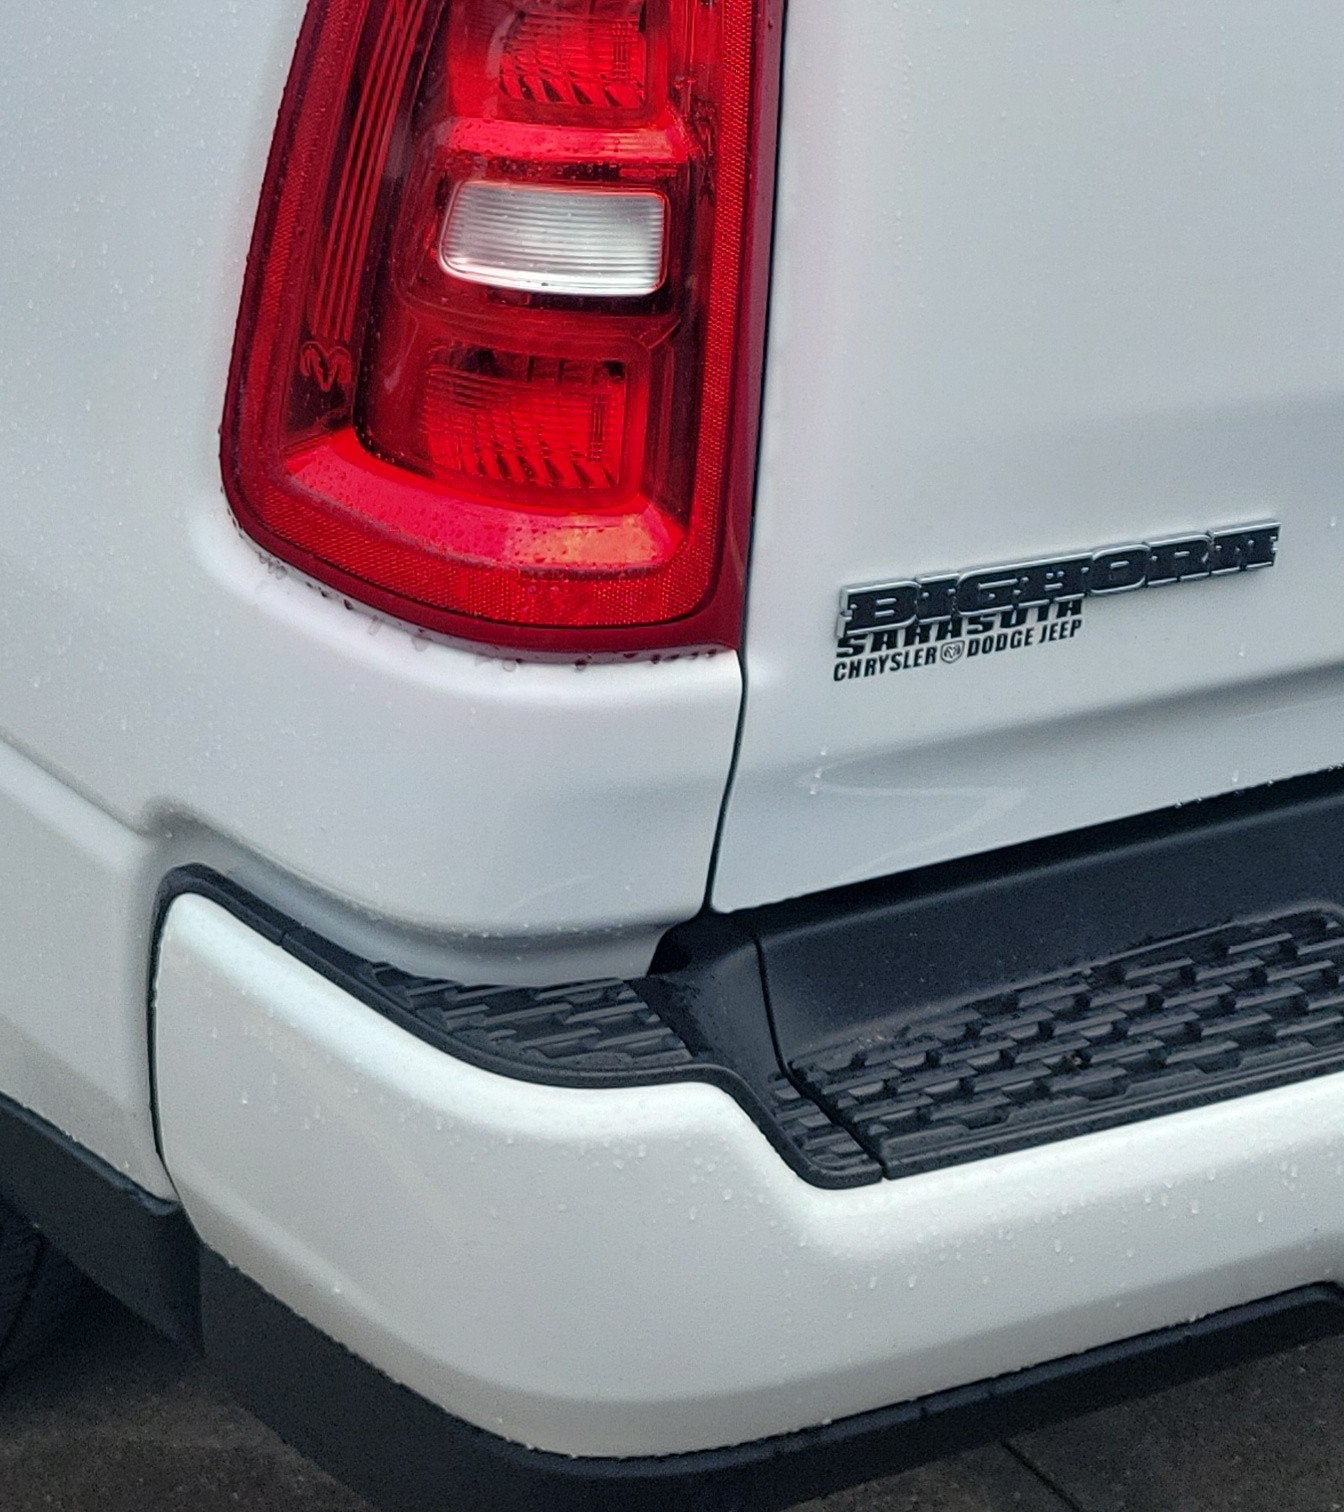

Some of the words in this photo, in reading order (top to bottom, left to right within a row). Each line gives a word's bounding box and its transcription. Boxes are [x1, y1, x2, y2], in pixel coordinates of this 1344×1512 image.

[833, 646, 938, 682] CHRYSLER
[966, 627, 1034, 658] DODGE
[1038, 619, 1083, 644] JEEP
